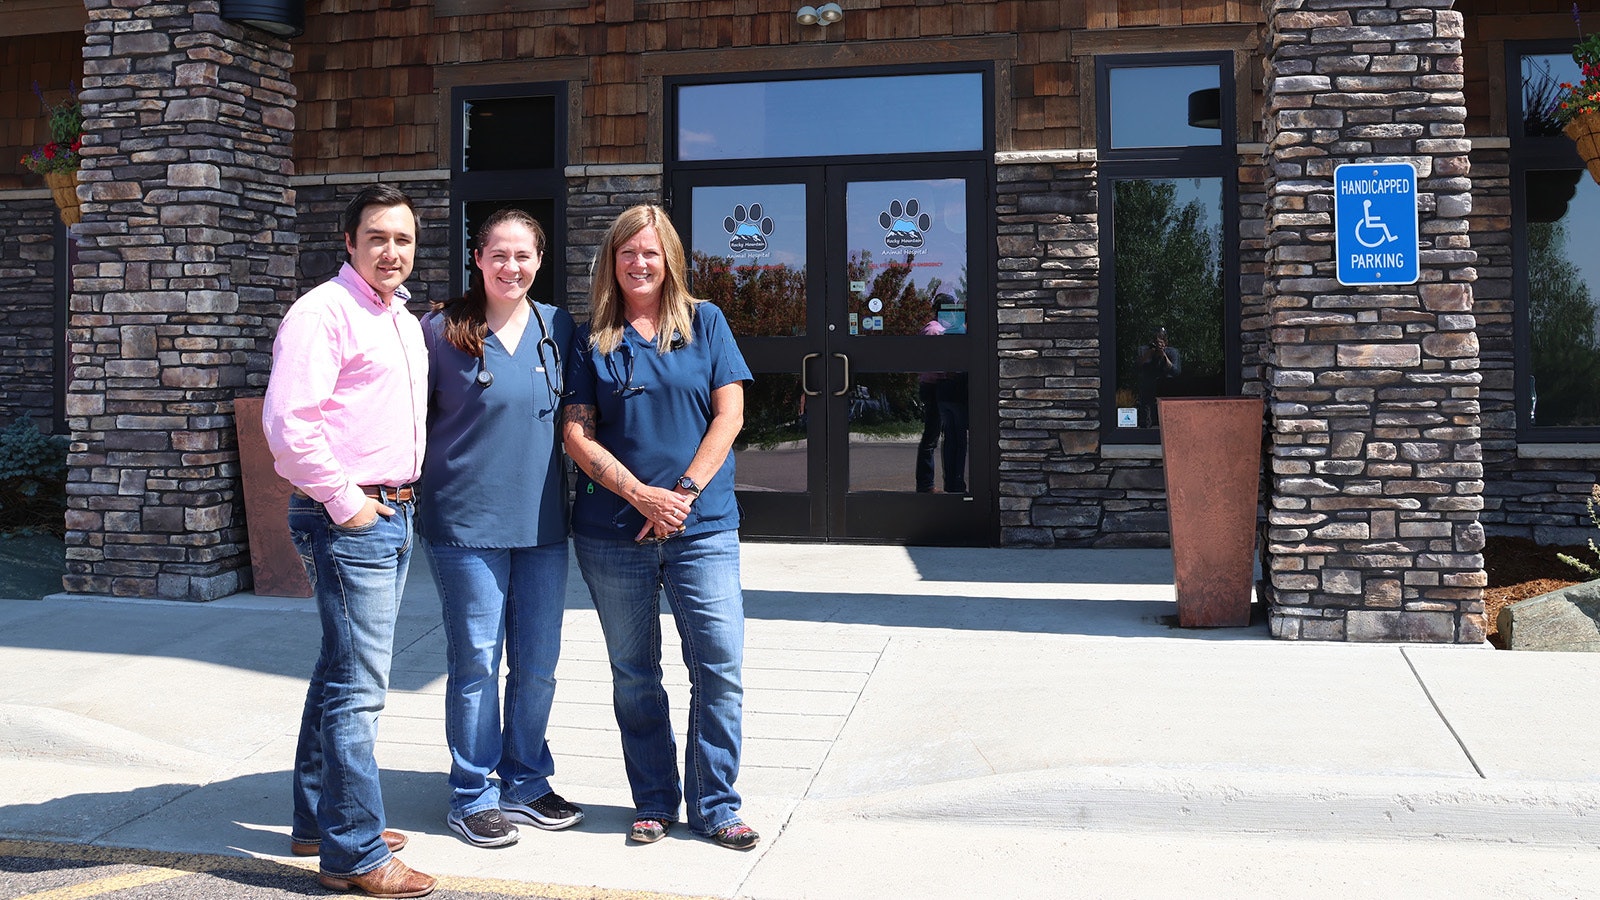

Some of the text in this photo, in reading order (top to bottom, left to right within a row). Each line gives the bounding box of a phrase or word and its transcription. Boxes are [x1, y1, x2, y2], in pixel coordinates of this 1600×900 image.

[1341, 178, 1410, 195] HANDICAPPED
[904, 248, 928, 256] Hospital
[1351, 253, 1404, 269] PARKING
